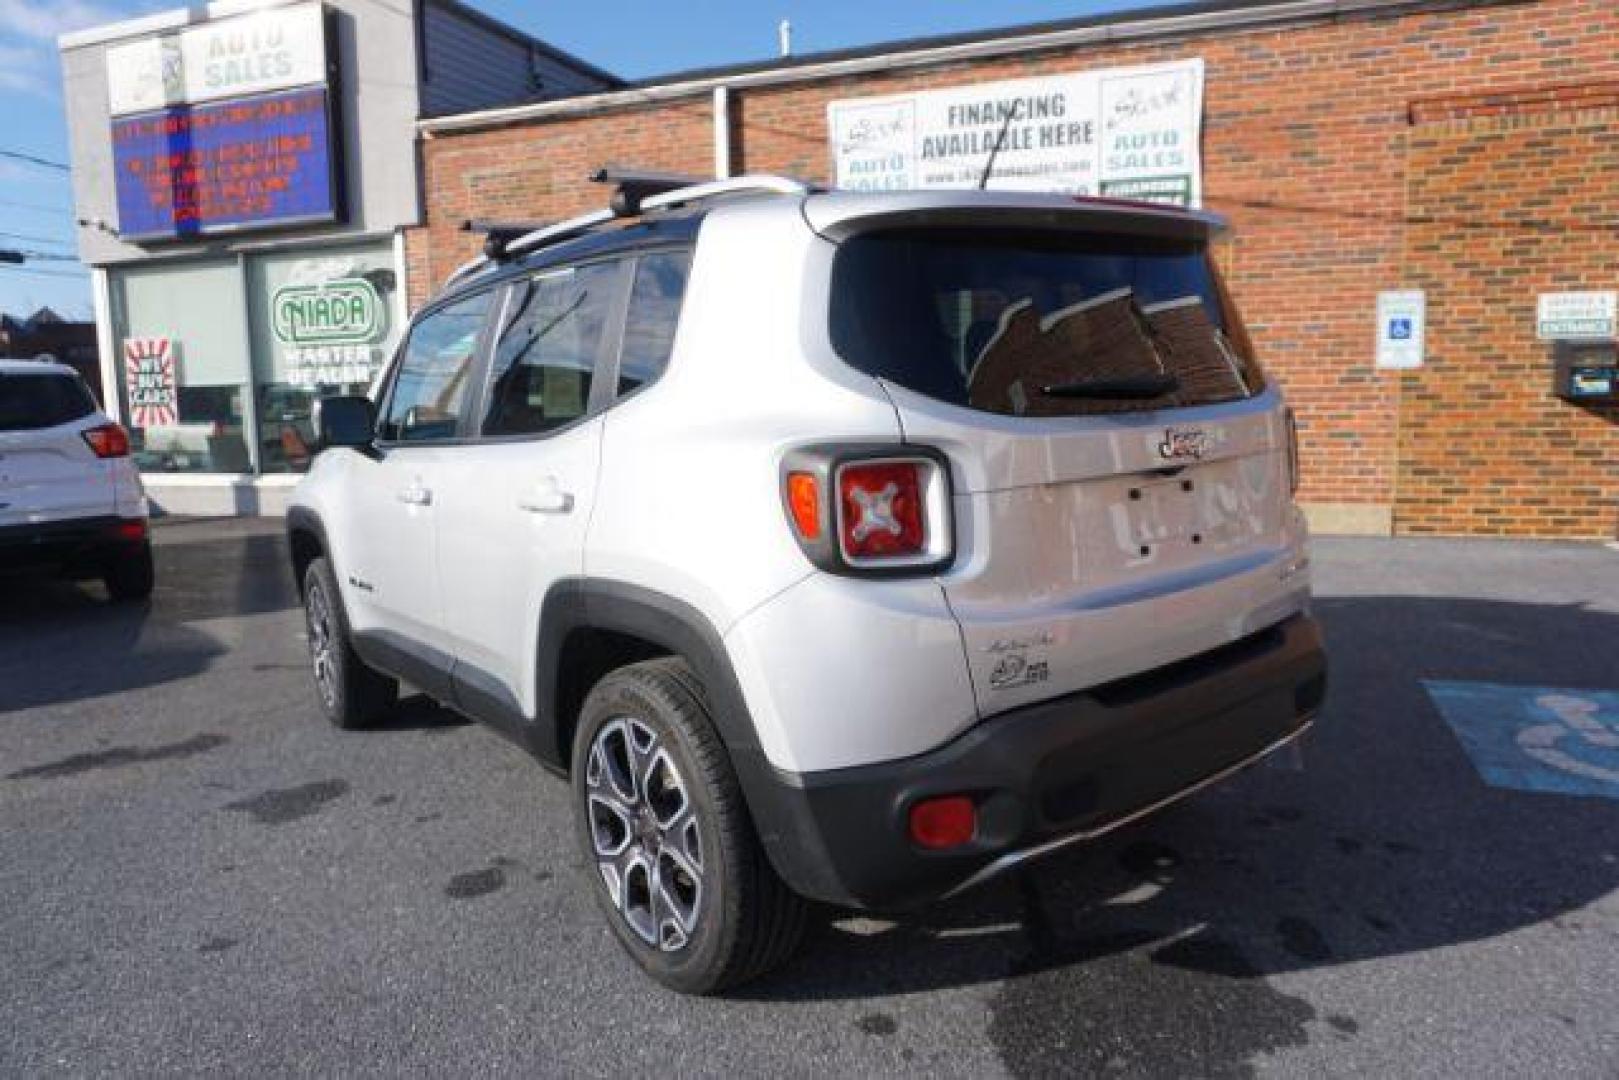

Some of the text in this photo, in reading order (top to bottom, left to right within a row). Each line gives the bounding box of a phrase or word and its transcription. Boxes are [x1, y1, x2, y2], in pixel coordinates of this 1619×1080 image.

[208, 21, 284, 58] AUTO
[205, 50, 293, 88] SALES
[948, 92, 1066, 128] FINANCING
[921, 126, 1033, 159] AVAILABLE
[1039, 120, 1094, 148] HERE
[1113, 129, 1179, 151] AUTO
[849, 152, 904, 176] AUTO
[1106, 150, 1184, 170] SALES
[282, 296, 365, 328] NIADA
[1158, 429, 1206, 460] Jeep
